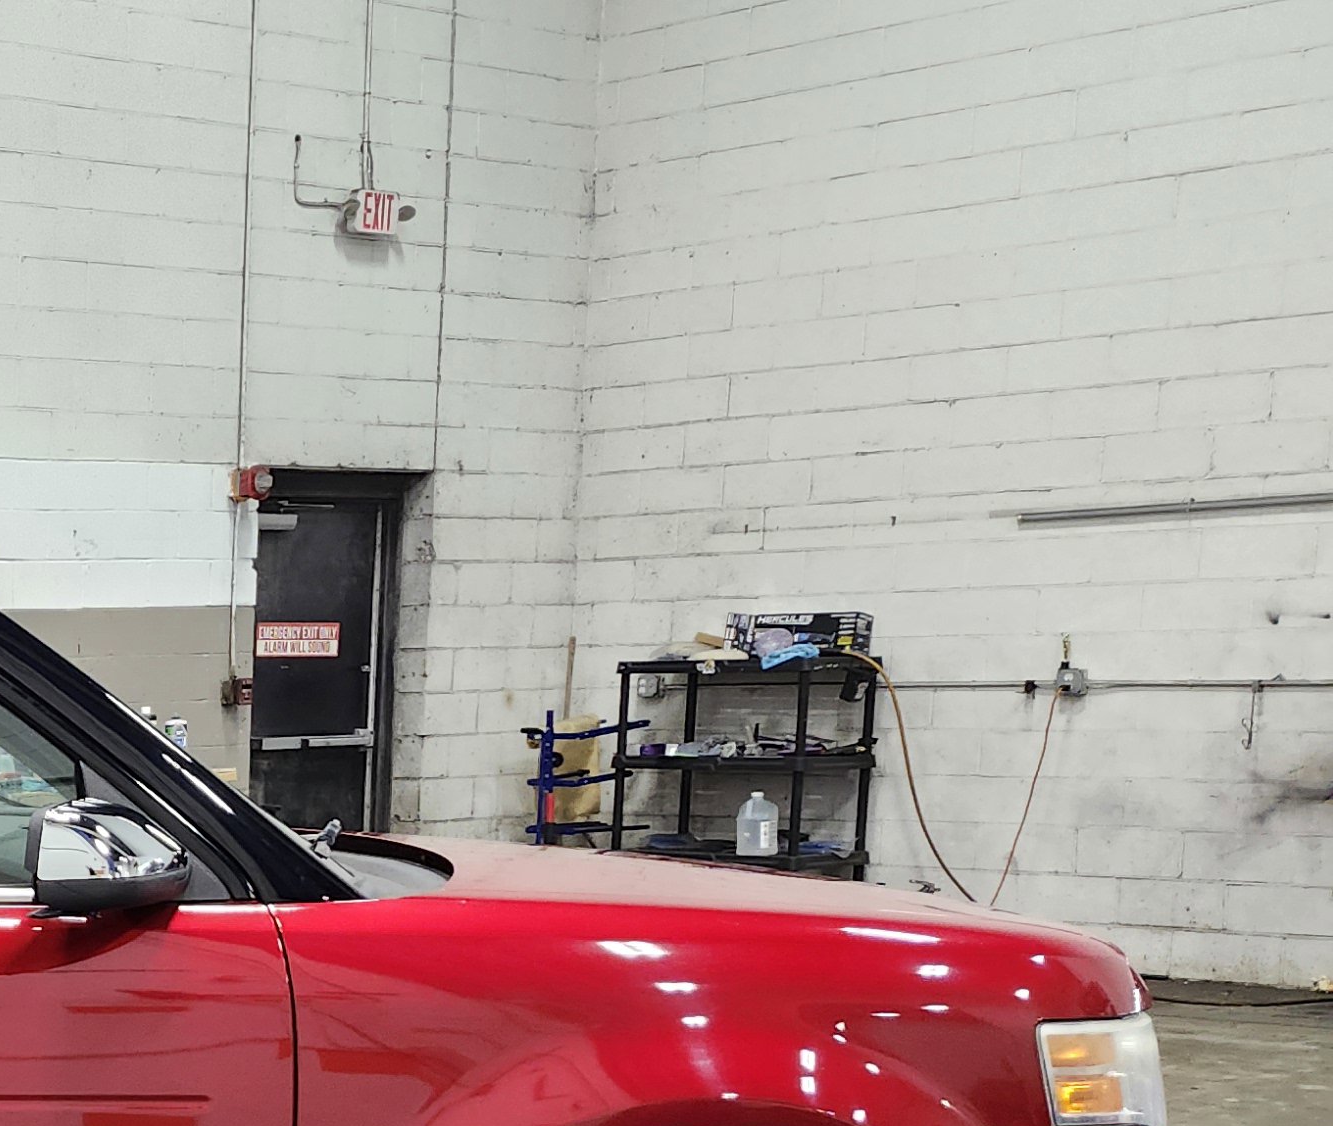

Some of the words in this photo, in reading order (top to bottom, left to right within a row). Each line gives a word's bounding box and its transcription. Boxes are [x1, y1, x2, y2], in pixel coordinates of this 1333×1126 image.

[363, 192, 394, 231] EXIT
[757, 615, 813, 625] HERCULES
[259, 626, 301, 639] EMERGENCY
[302, 626, 318, 639] EXIT
[319, 626, 337, 639] ONLY
[264, 641, 288, 653] ALARM
[289, 641, 306, 653] WILL
[308, 641, 330, 653] SOUND
